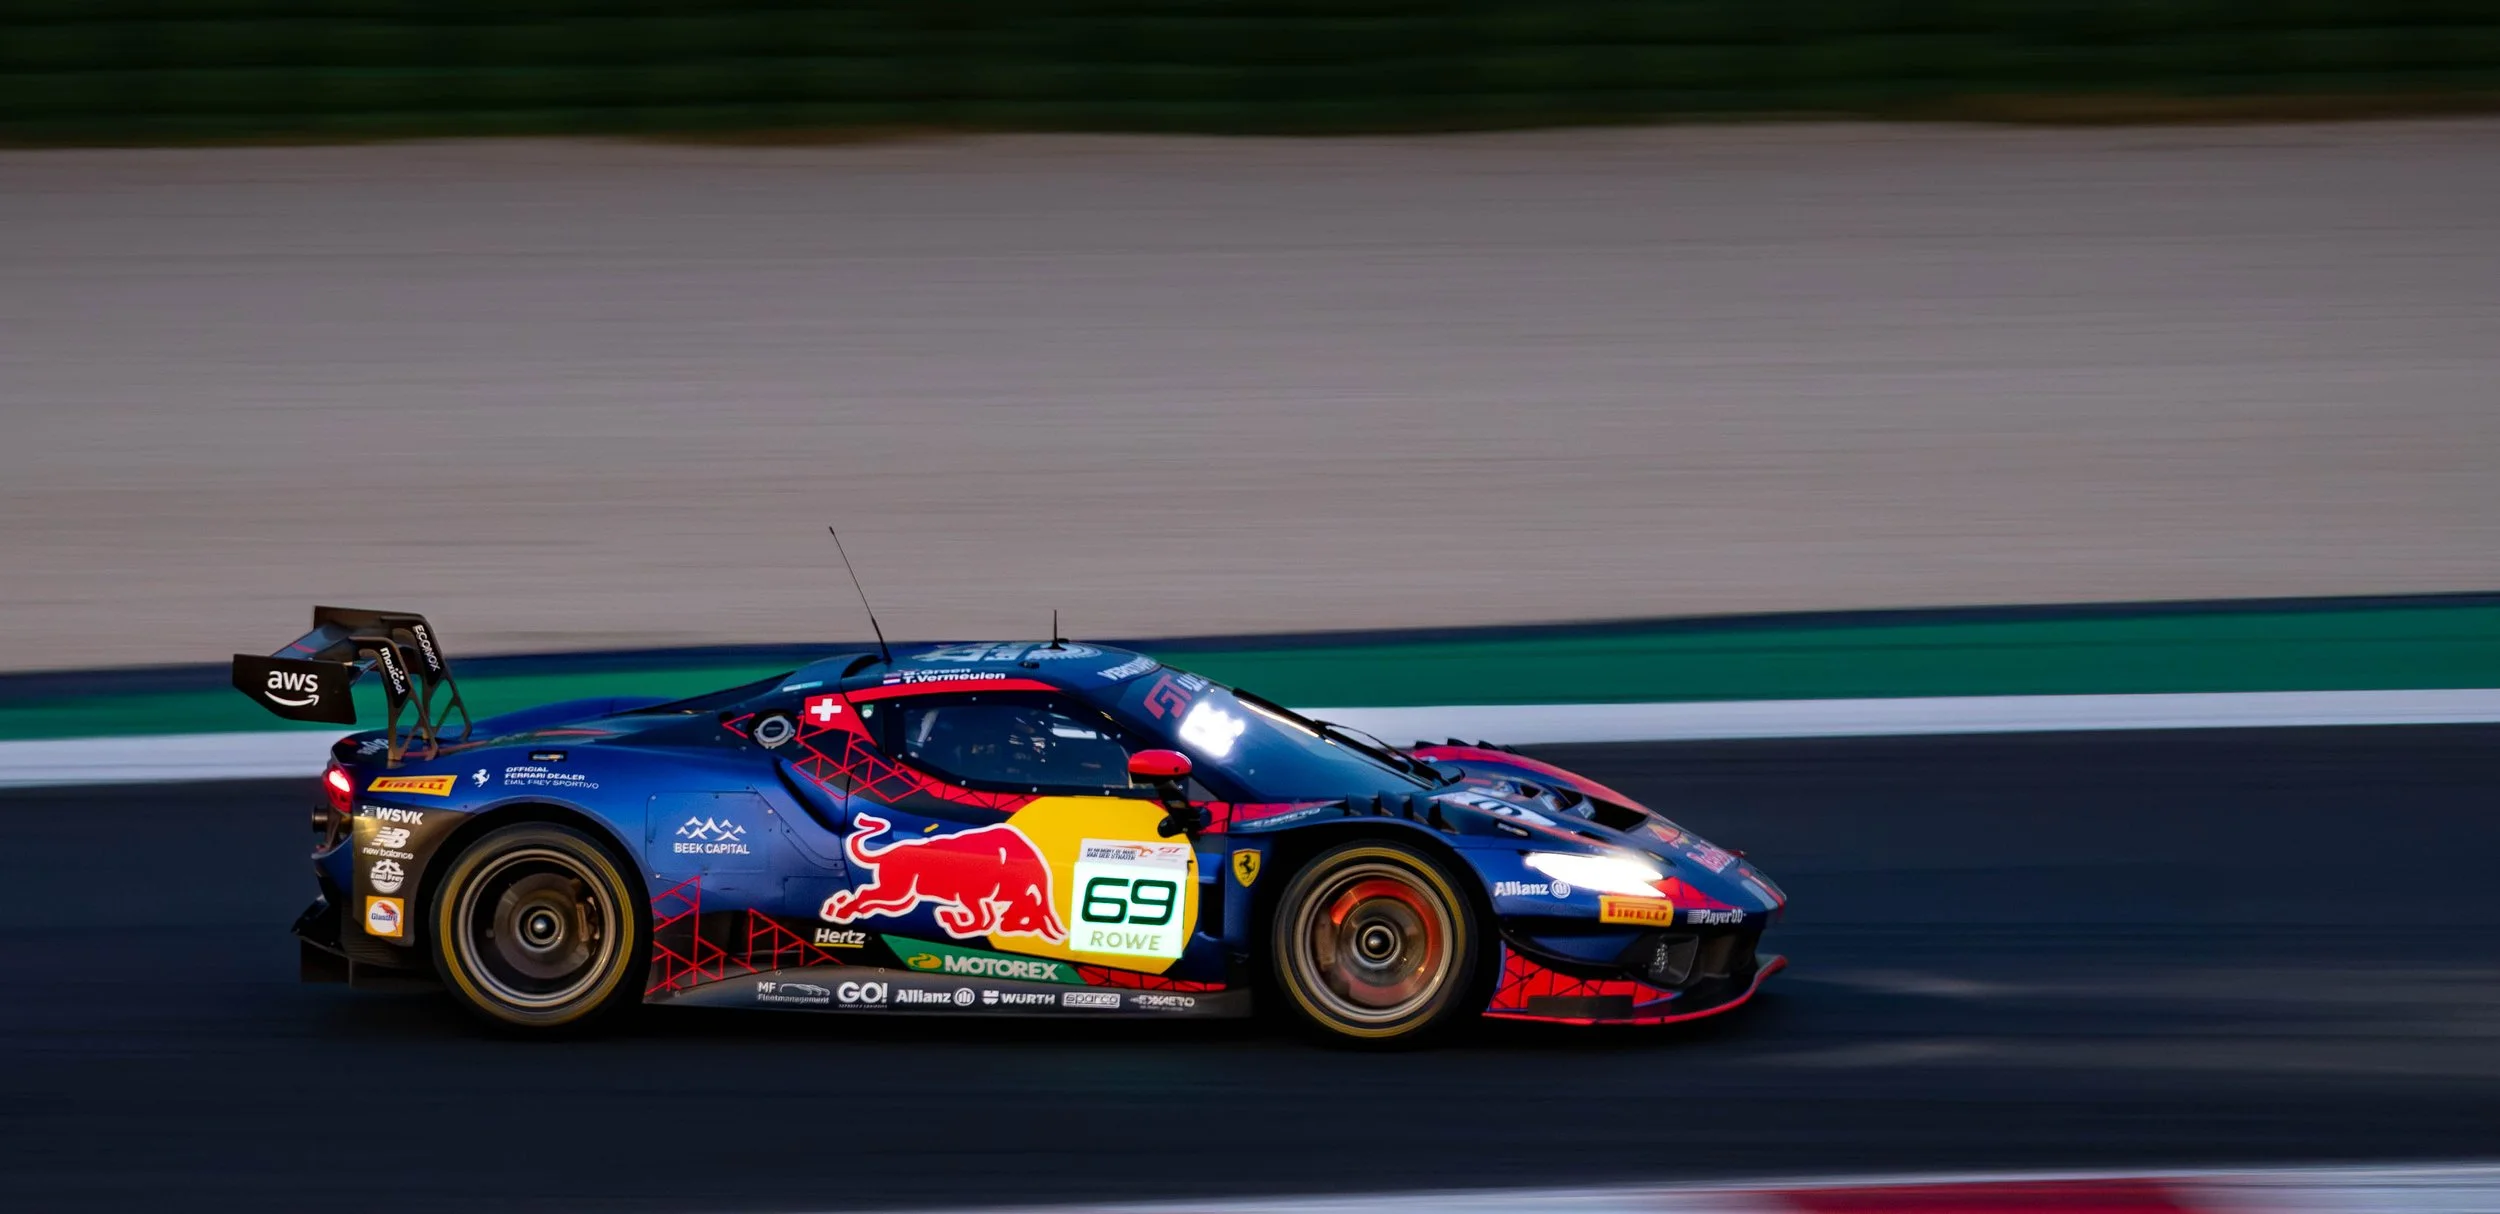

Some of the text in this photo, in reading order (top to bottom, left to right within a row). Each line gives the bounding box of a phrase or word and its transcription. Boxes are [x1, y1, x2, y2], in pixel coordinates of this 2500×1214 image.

[413, 624, 440, 672] ECONOX
[267, 670, 319, 693] aws
[903, 672, 1006, 684] T.Vermeulen
[377, 779, 448, 790] PIRELLI
[504, 772, 585, 781] FERRARI DEALER
[504, 779, 525, 787] EMIL
[552, 780, 600, 790] SPORTIVO
[376, 806, 424, 825] WSVK
[362, 847, 414, 860] new balance
[674, 842, 750, 855] BEEK CAPITAL
[1494, 882, 1549, 897] Allianz
[1081, 876, 1178, 927] 69
[1608, 902, 1667, 921] PIRELLI
[815, 928, 866, 945] Hertz
[1089, 930, 1163, 951] ROWE
[944, 954, 1060, 981] MOTOREX
[756, 981, 777, 993] MF
[837, 981, 888, 1004] GO!
[896, 989, 951, 1004] Allianz
